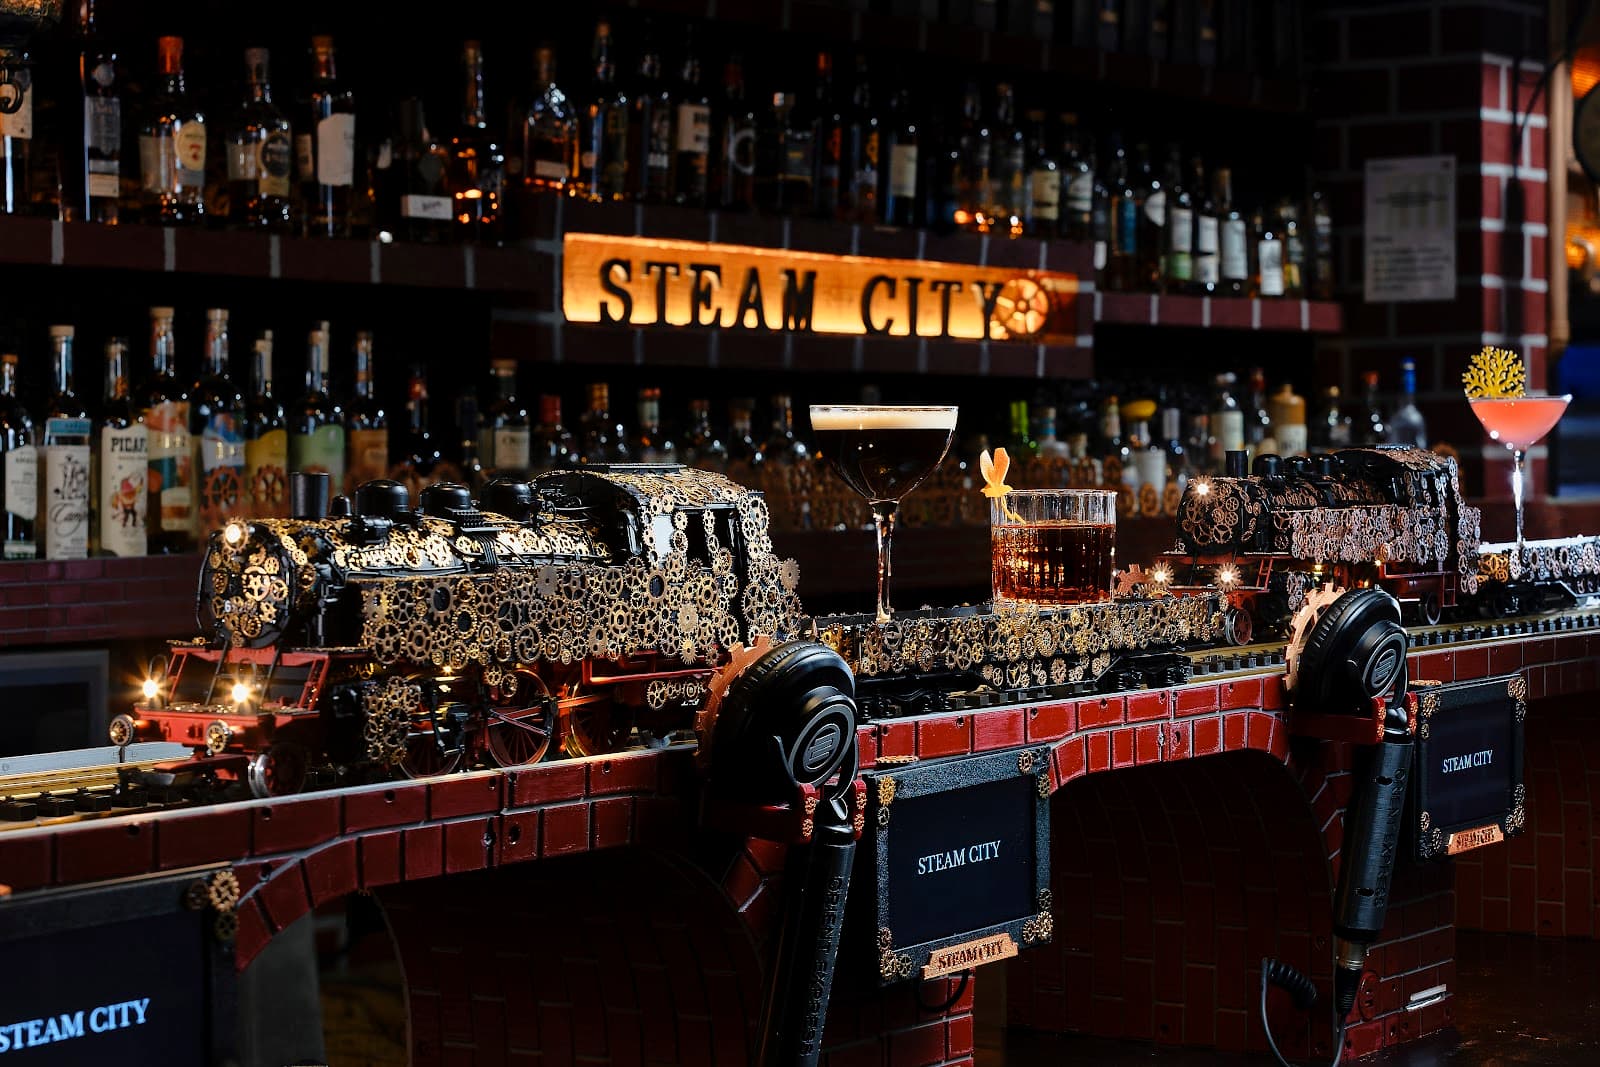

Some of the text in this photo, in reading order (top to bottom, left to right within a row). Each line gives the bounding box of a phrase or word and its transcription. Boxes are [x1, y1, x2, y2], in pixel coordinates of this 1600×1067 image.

[600, 258, 1003, 339] STEAM CITY
[1442, 749, 1493, 774] STEAM CITY
[918, 840, 1001, 875] STEAM CITY
[937, 938, 1005, 971] STEAM CITY
[0, 997, 151, 1054] STEAM CITY
